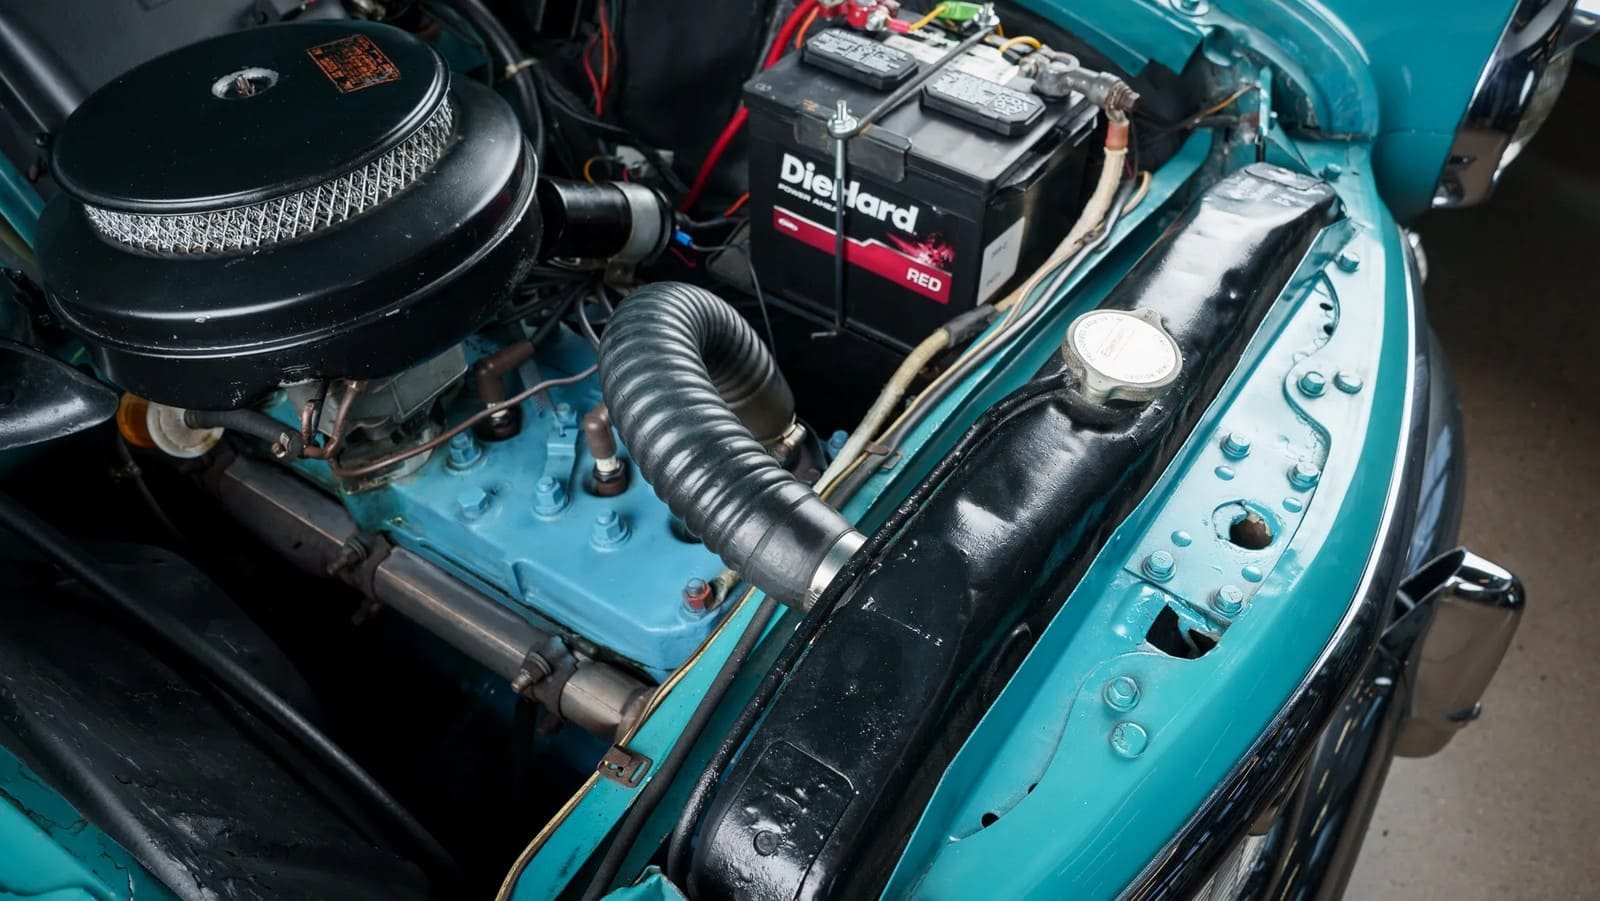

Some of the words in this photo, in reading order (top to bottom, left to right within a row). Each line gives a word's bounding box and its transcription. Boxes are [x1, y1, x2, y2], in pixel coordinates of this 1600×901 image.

[778, 183, 811, 202] POWER
[780, 153, 919, 233] DieHard
[906, 267, 942, 292] RED
